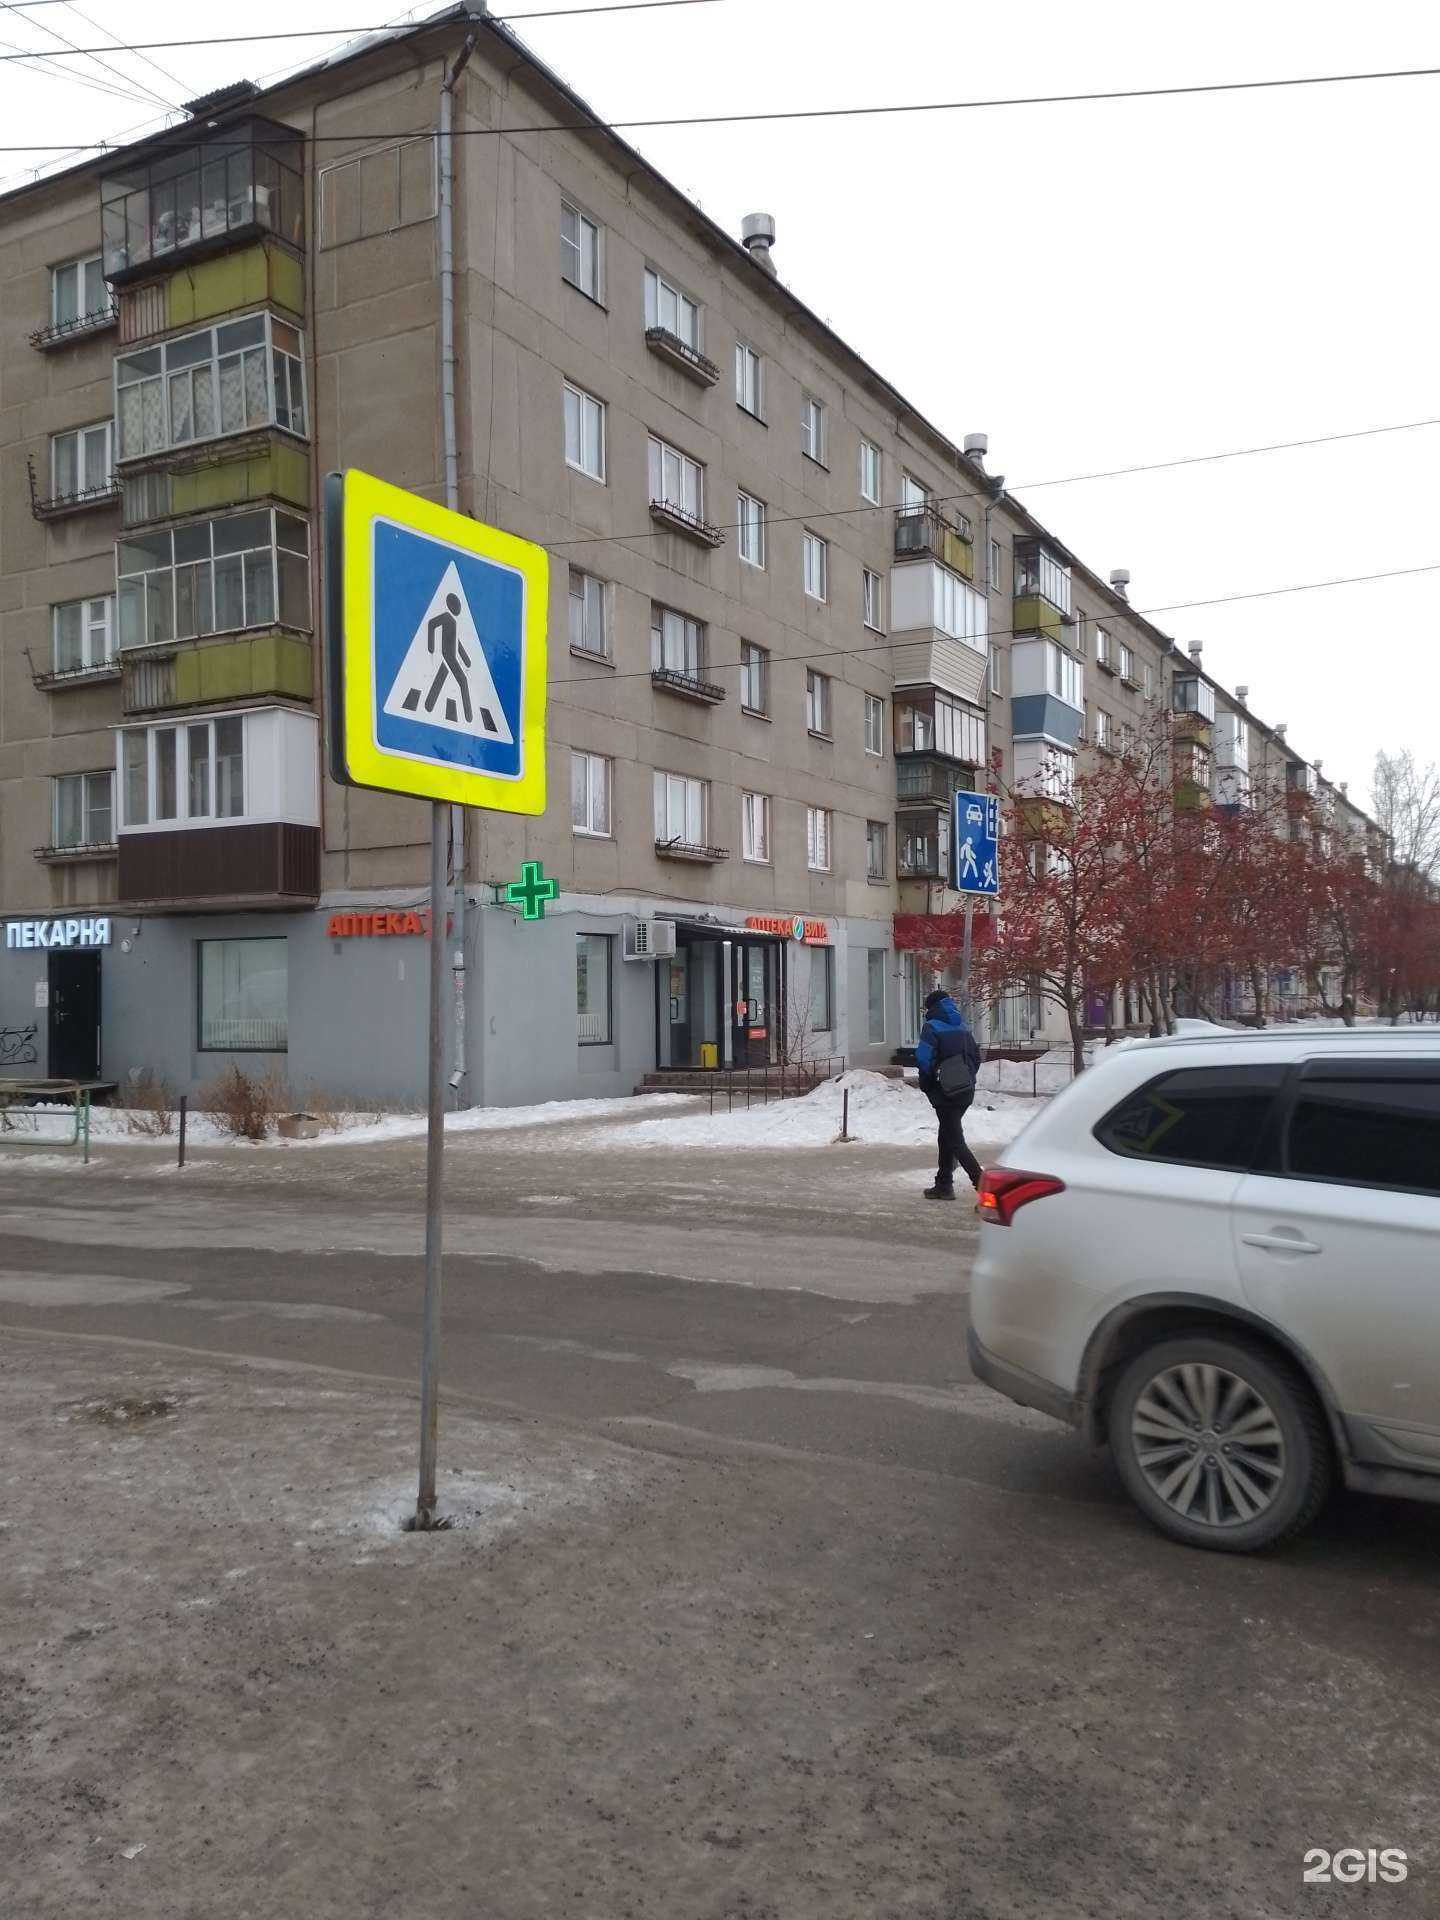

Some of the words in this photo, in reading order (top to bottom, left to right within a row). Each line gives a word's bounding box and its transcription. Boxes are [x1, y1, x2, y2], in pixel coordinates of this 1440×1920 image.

[7, 918, 111, 948] ПЕКАРНЯ
[327, 912, 421, 937] АПТЕКА
[747, 917, 792, 936] АПТЕКА
[804, 920, 828, 938] ВИТА
